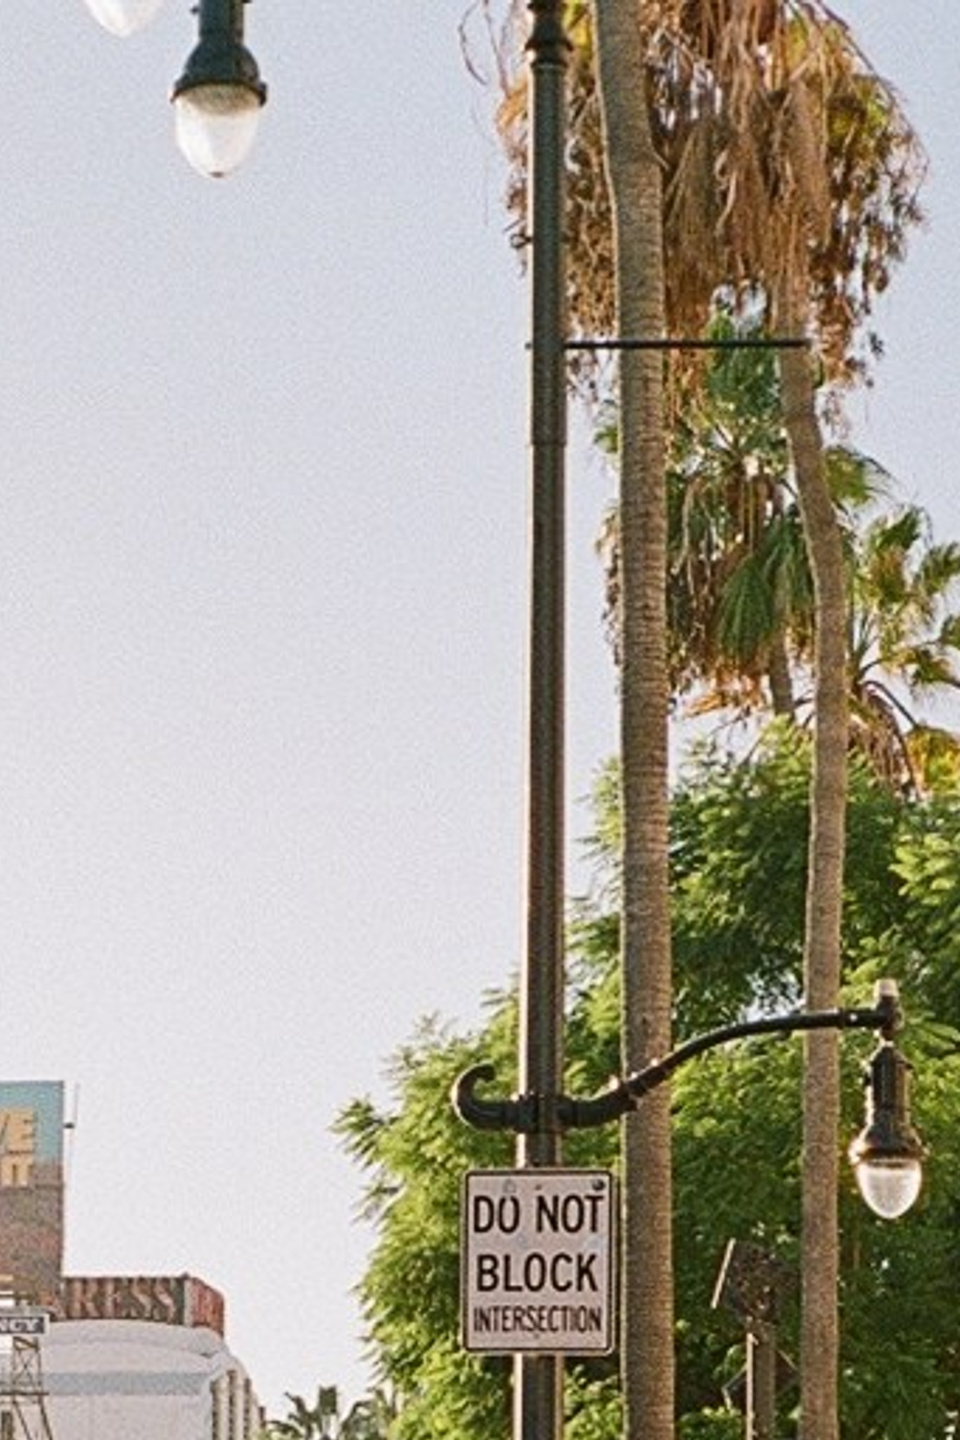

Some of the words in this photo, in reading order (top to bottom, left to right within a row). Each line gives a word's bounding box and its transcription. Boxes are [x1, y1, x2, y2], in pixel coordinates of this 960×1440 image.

[473, 1195, 520, 1234] DO
[536, 1194, 605, 1234] NOT
[476, 1252, 599, 1293] BLOCK
[473, 1304, 602, 1334] INTERSECTION
